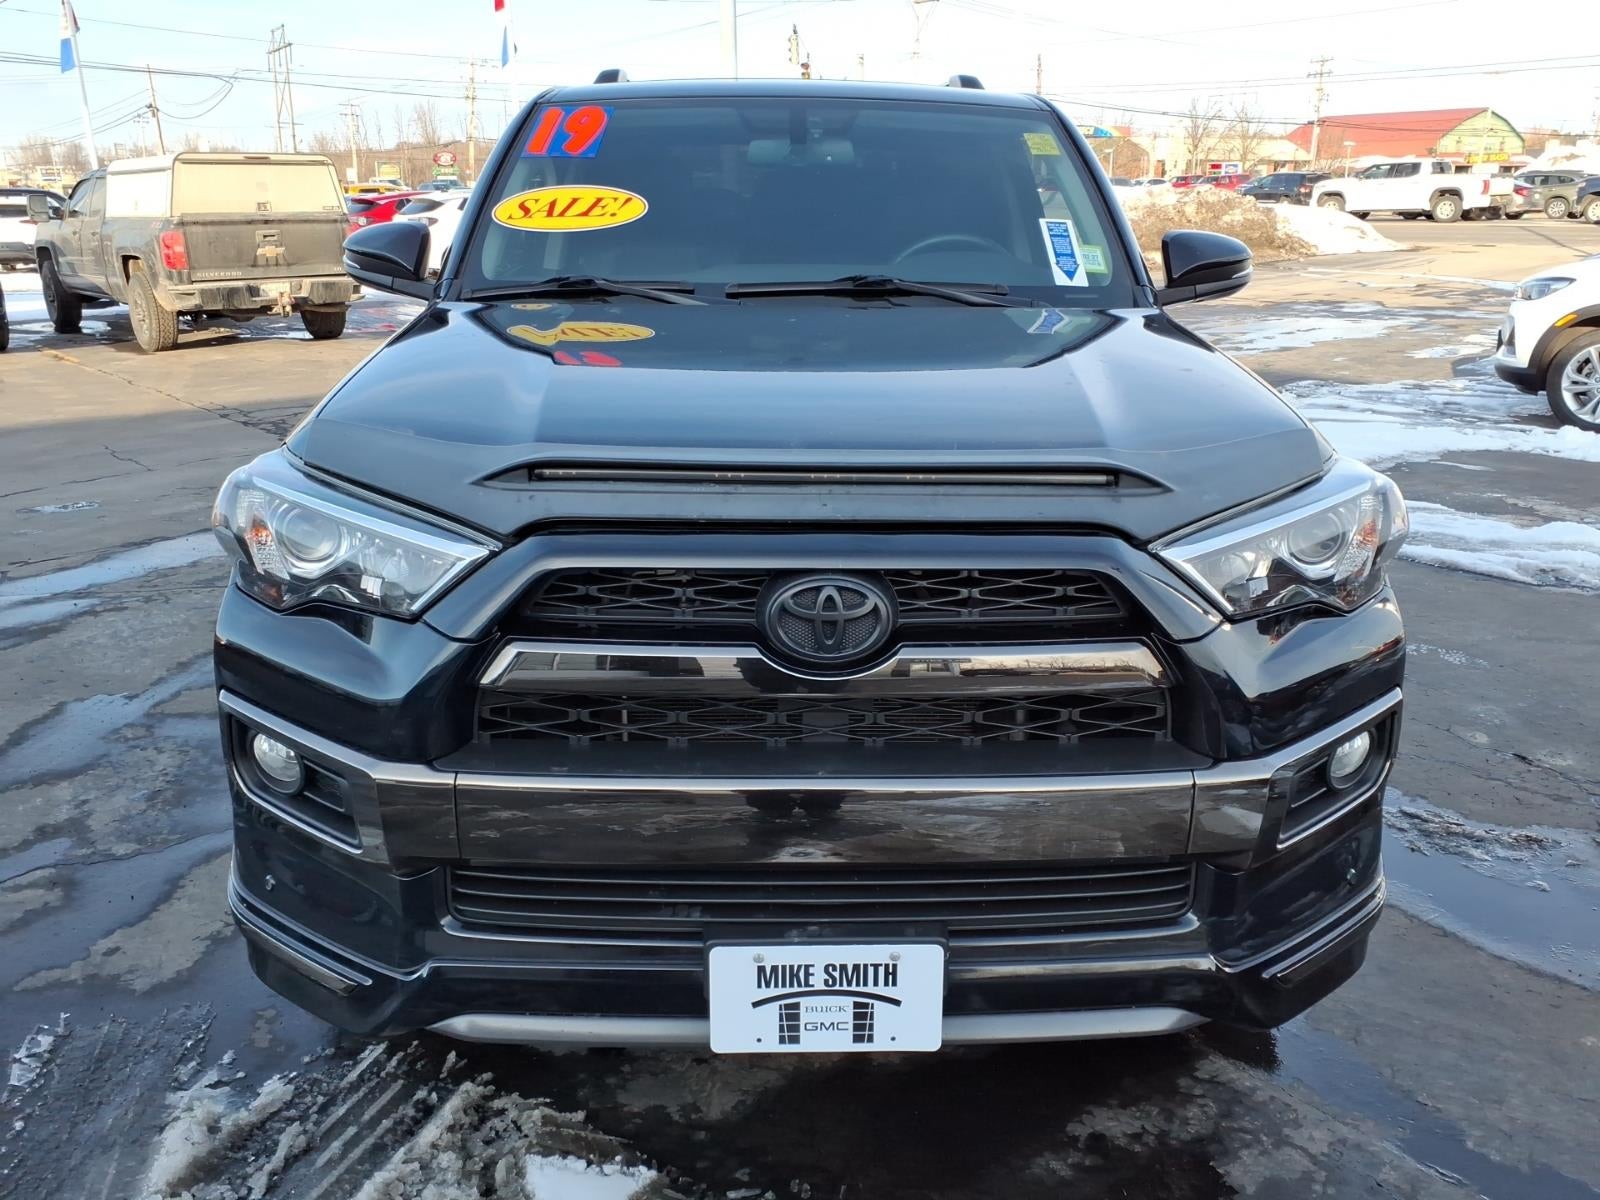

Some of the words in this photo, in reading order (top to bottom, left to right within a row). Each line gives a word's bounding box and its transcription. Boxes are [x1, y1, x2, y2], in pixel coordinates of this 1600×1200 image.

[525, 105, 607, 156] 19
[506, 197, 632, 220] SALE!
[757, 964, 815, 989] MIKE
[824, 963, 898, 988] SMITH
[804, 1005, 849, 1013] BUICK
[804, 1021, 849, 1031] GMC
